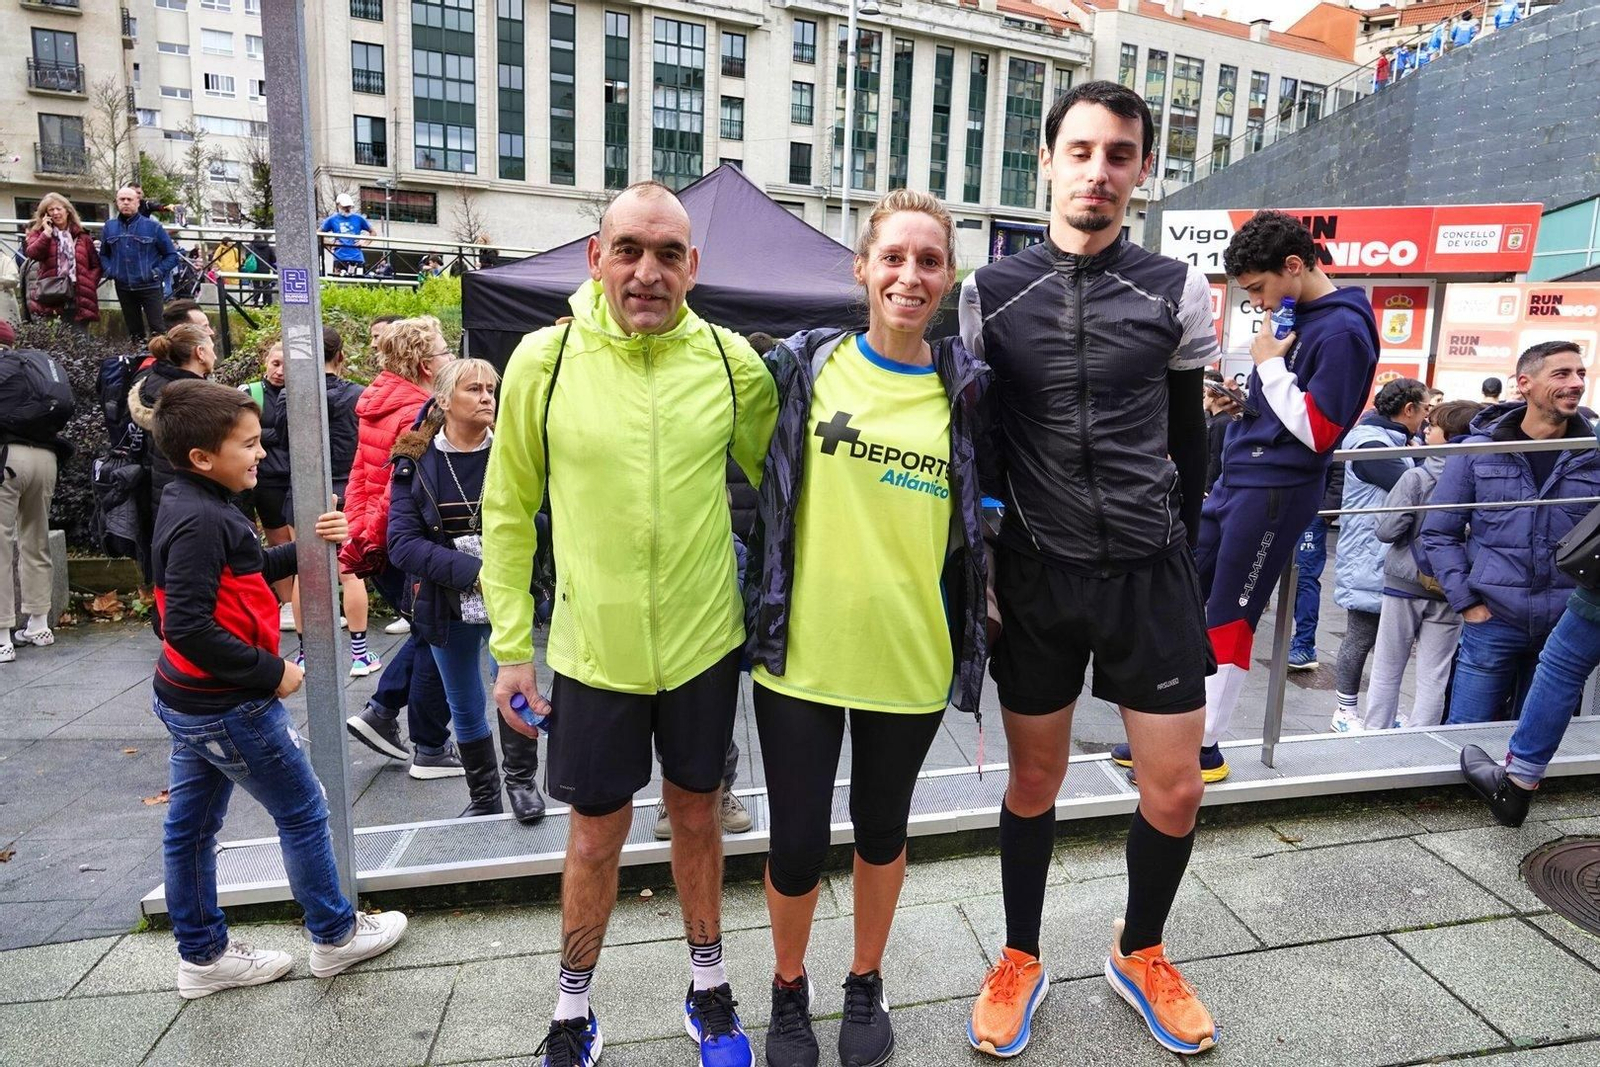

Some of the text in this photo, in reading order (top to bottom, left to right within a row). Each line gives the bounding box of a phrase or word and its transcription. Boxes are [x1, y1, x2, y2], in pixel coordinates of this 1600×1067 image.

[1168, 226, 1229, 244] Vigo
[1442, 230, 1496, 239] CONCELLO
[1464, 239, 1488, 247] VIGO
[1530, 294, 1563, 305] RUN
[1450, 336, 1480, 346] RUN
[880, 469, 949, 500] Atlántico
